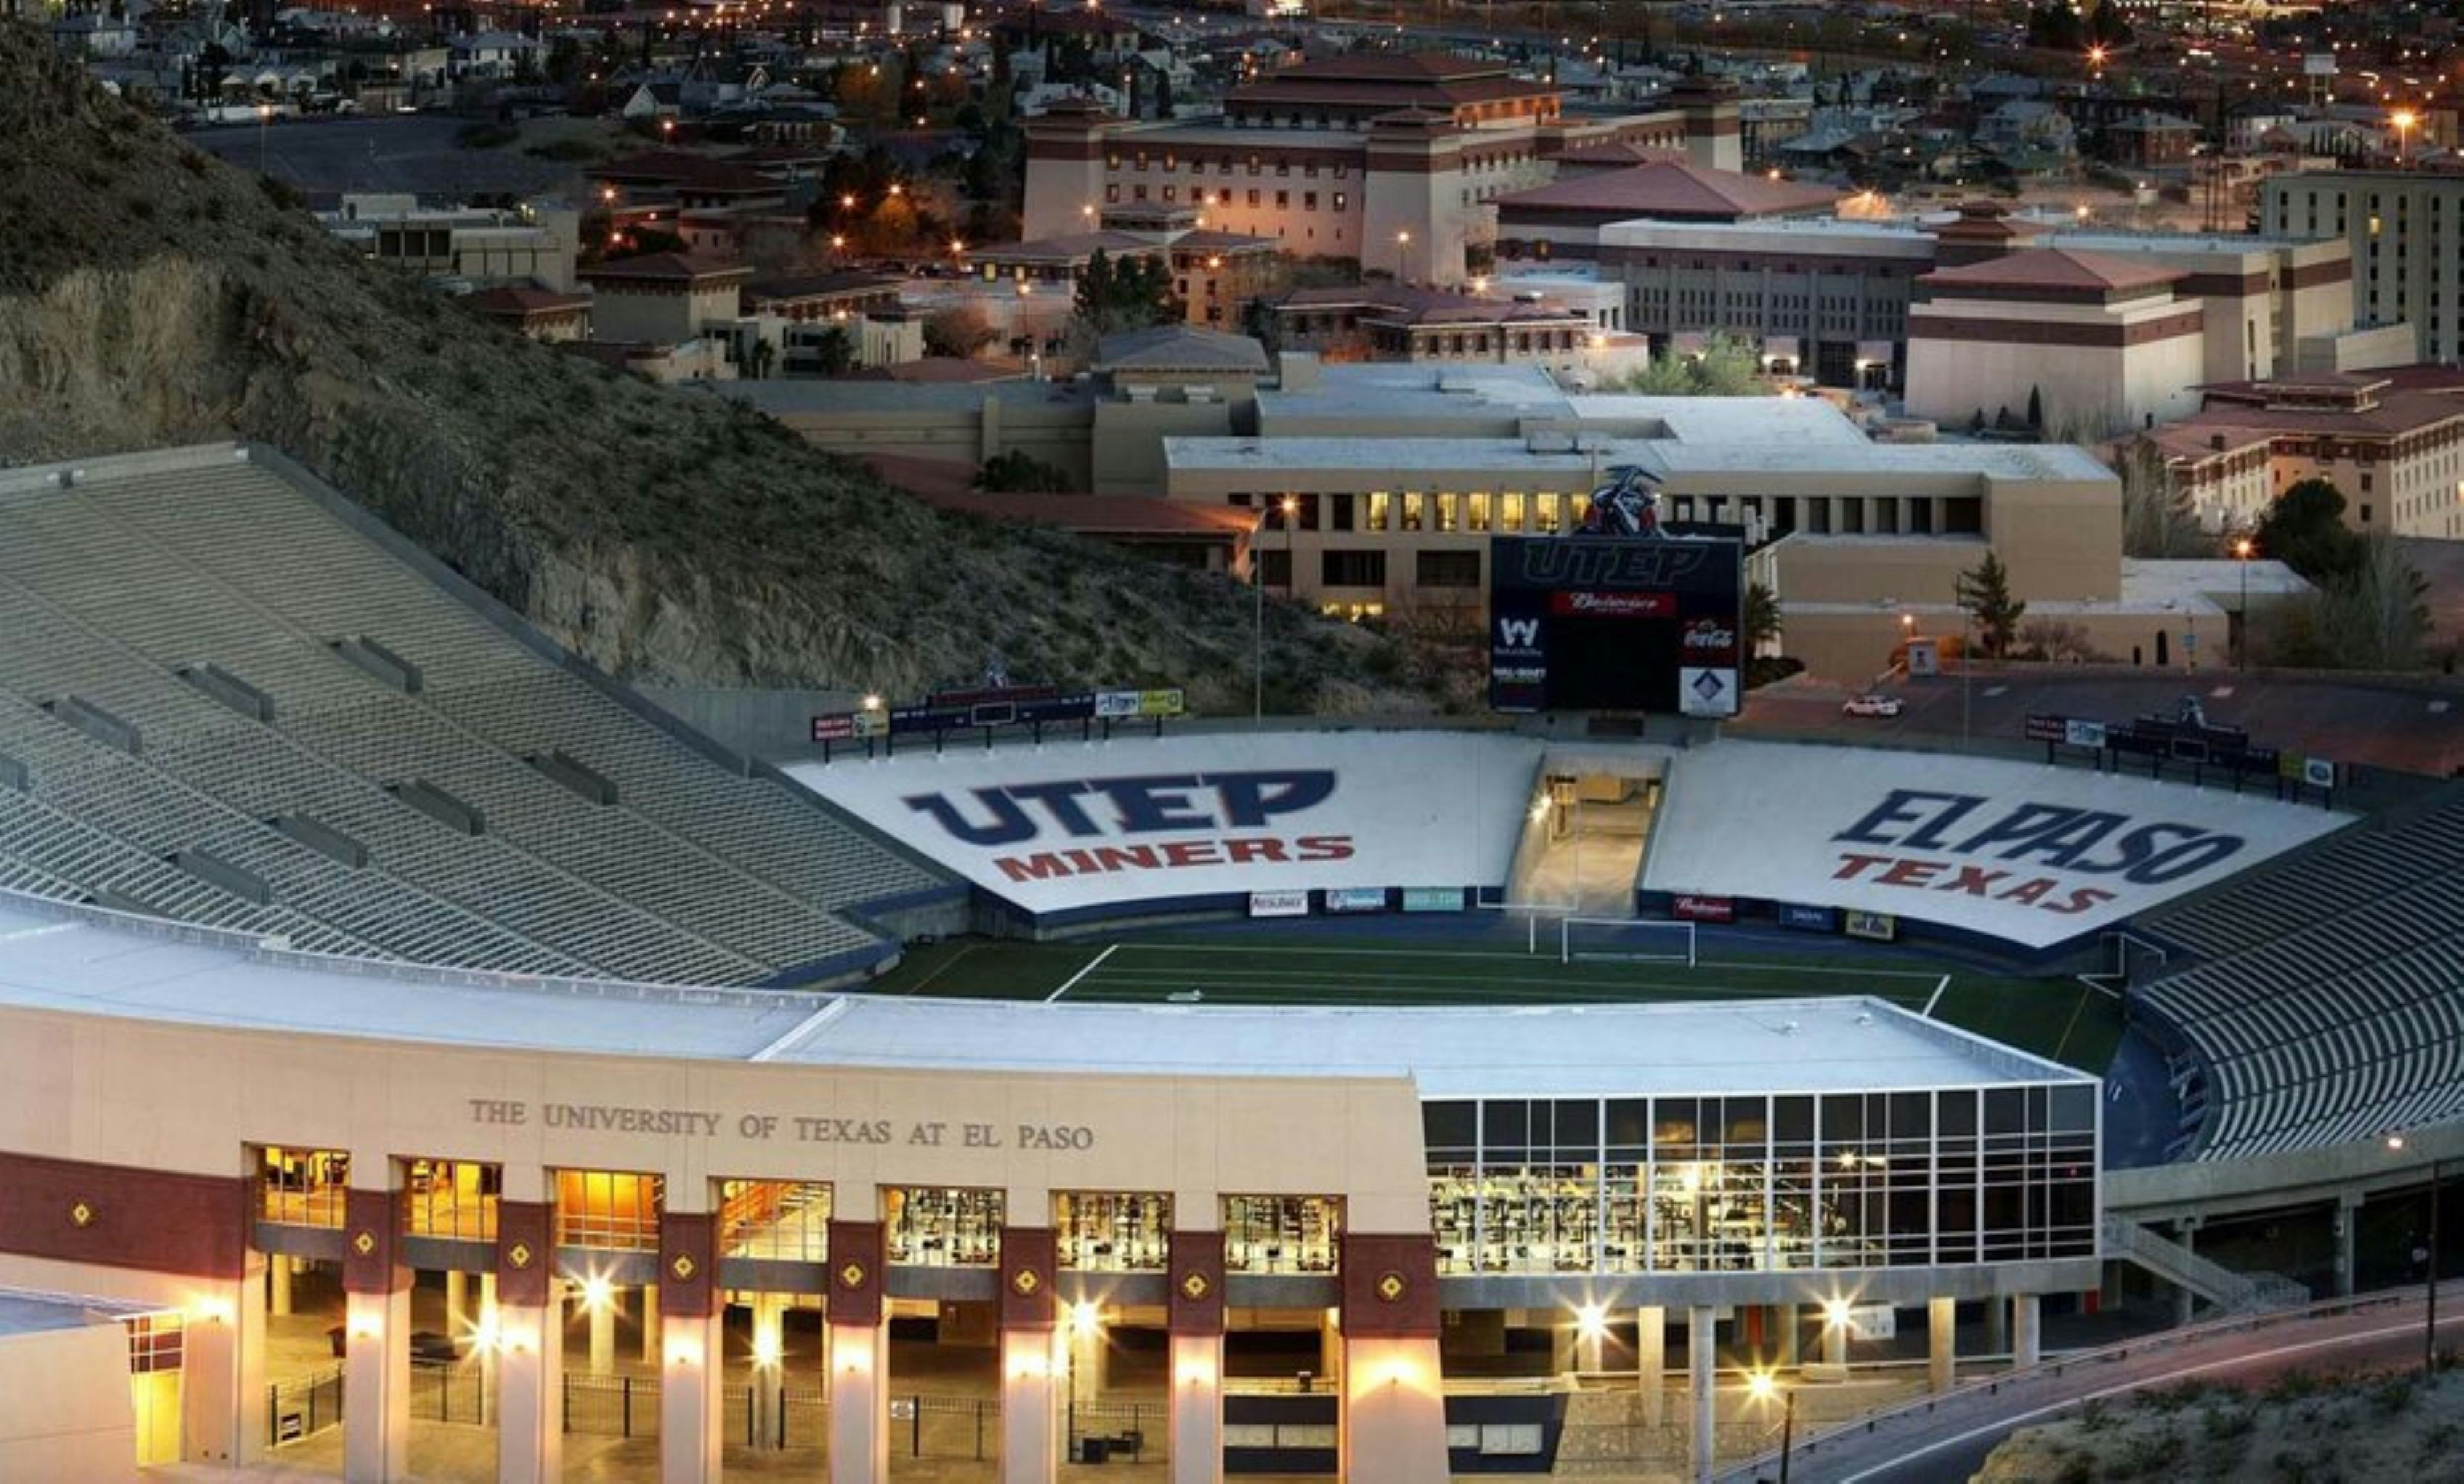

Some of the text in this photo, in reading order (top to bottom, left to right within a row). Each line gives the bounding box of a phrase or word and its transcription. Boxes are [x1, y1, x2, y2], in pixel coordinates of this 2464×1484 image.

[1524, 540, 1709, 585] UTEP
[902, 769, 1337, 845] UTEP
[992, 836, 1356, 882] MINERS
[1830, 789, 2246, 885] EL PASO
[1831, 854, 2118, 914] TEXAS
[469, 1099, 1093, 1150] THE UNIVERSITY OF TEXAS AT EL PASO
